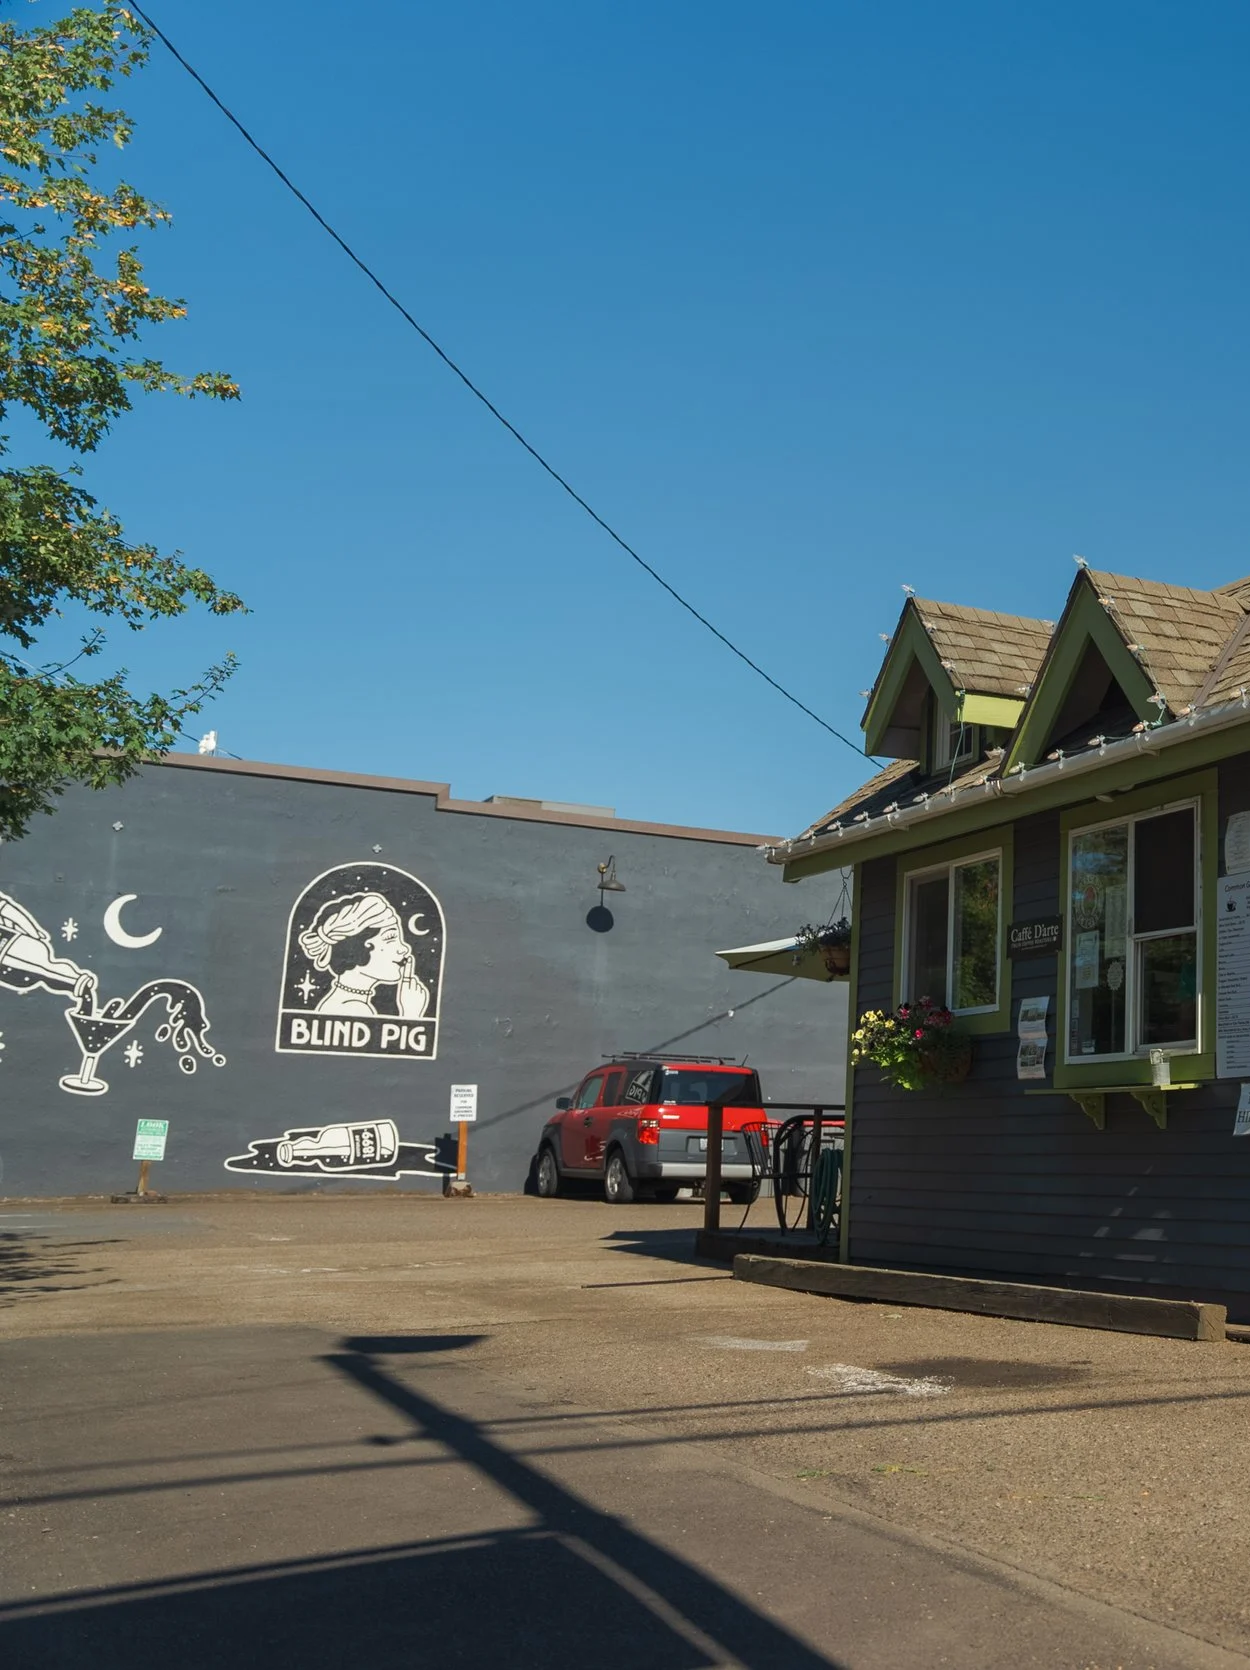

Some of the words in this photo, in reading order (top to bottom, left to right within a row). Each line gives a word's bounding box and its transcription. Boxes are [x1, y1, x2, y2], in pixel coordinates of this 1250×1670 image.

[1224, 882, 1246, 892] Common
[290, 1018, 371, 1047] BLIND
[380, 1023, 426, 1051] PIG
